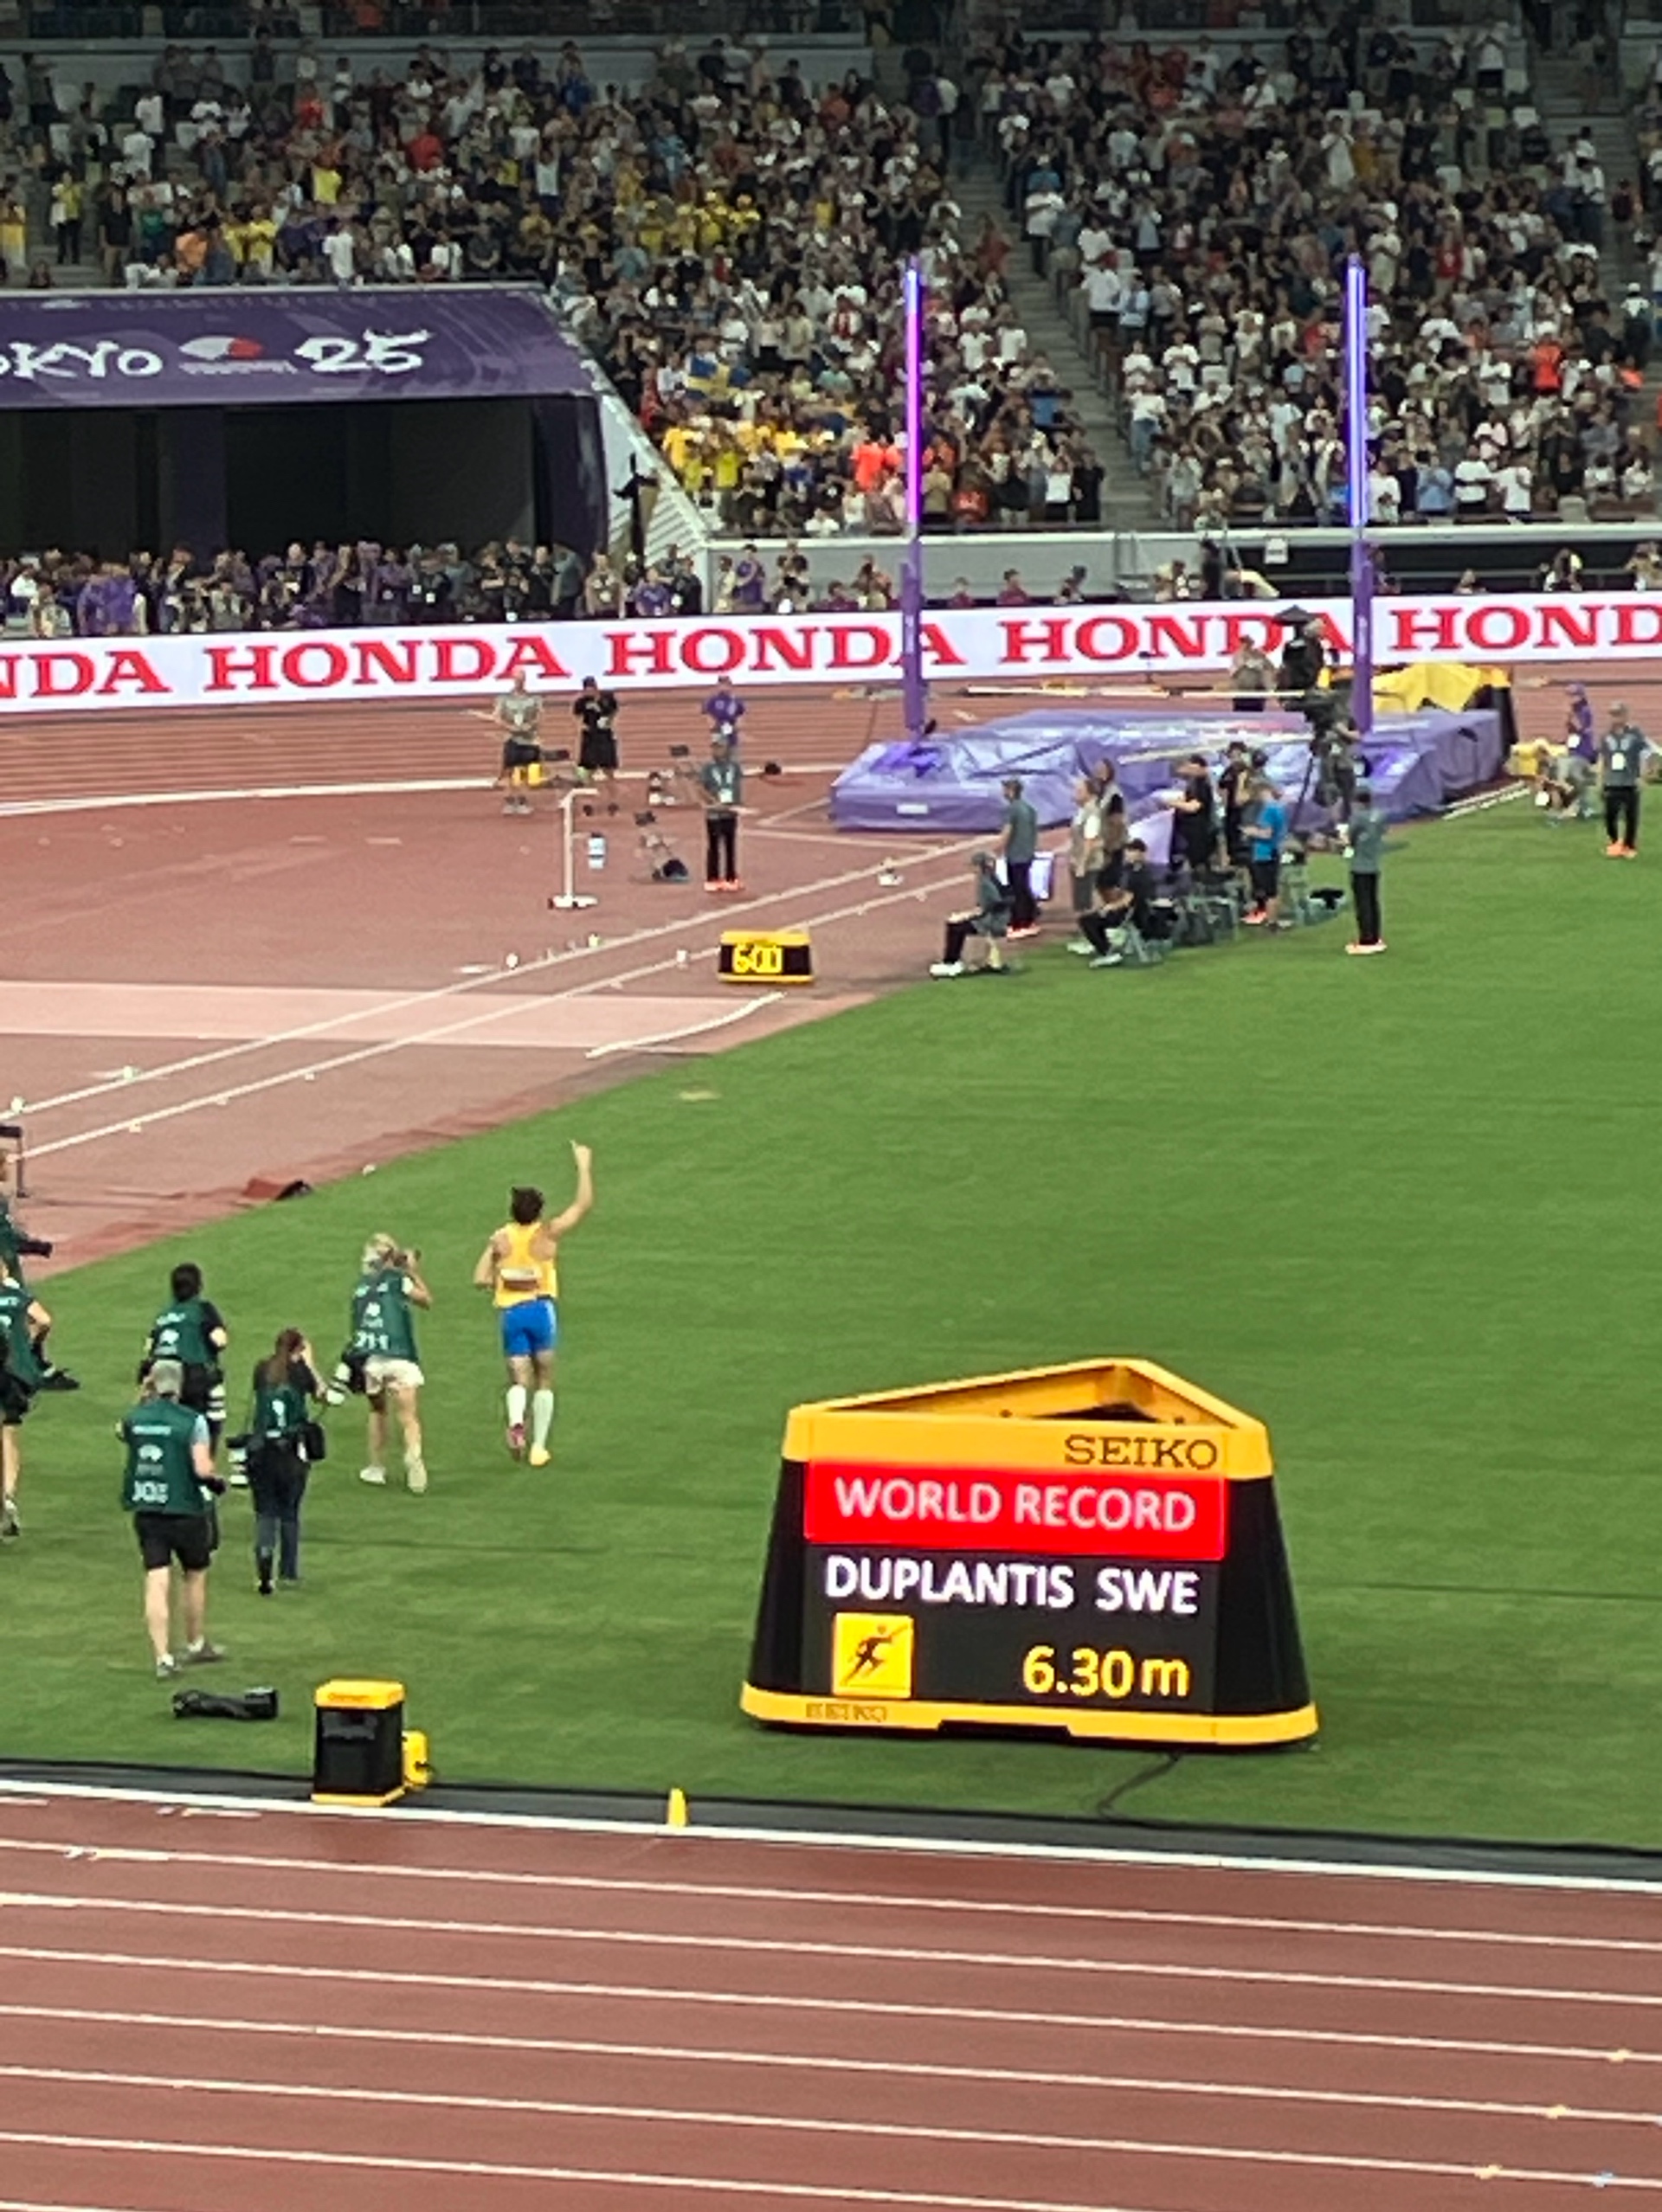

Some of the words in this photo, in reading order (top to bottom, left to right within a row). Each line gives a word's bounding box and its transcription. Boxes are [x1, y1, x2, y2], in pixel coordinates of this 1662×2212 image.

[0, 339, 164, 381] KYO
[293, 328, 433, 374] 25
[204, 636, 570, 691] HONDA
[605, 623, 967, 676] HONDA
[1388, 603, 1662, 652] HOND
[1065, 1434, 1218, 1470] SEIKO
[834, 1476, 1002, 1523] WORLD
[1014, 1484, 1197, 1532] RECORD
[825, 1555, 1075, 1610] DUPLANTIS
[1095, 1568, 1201, 1615] SWE
